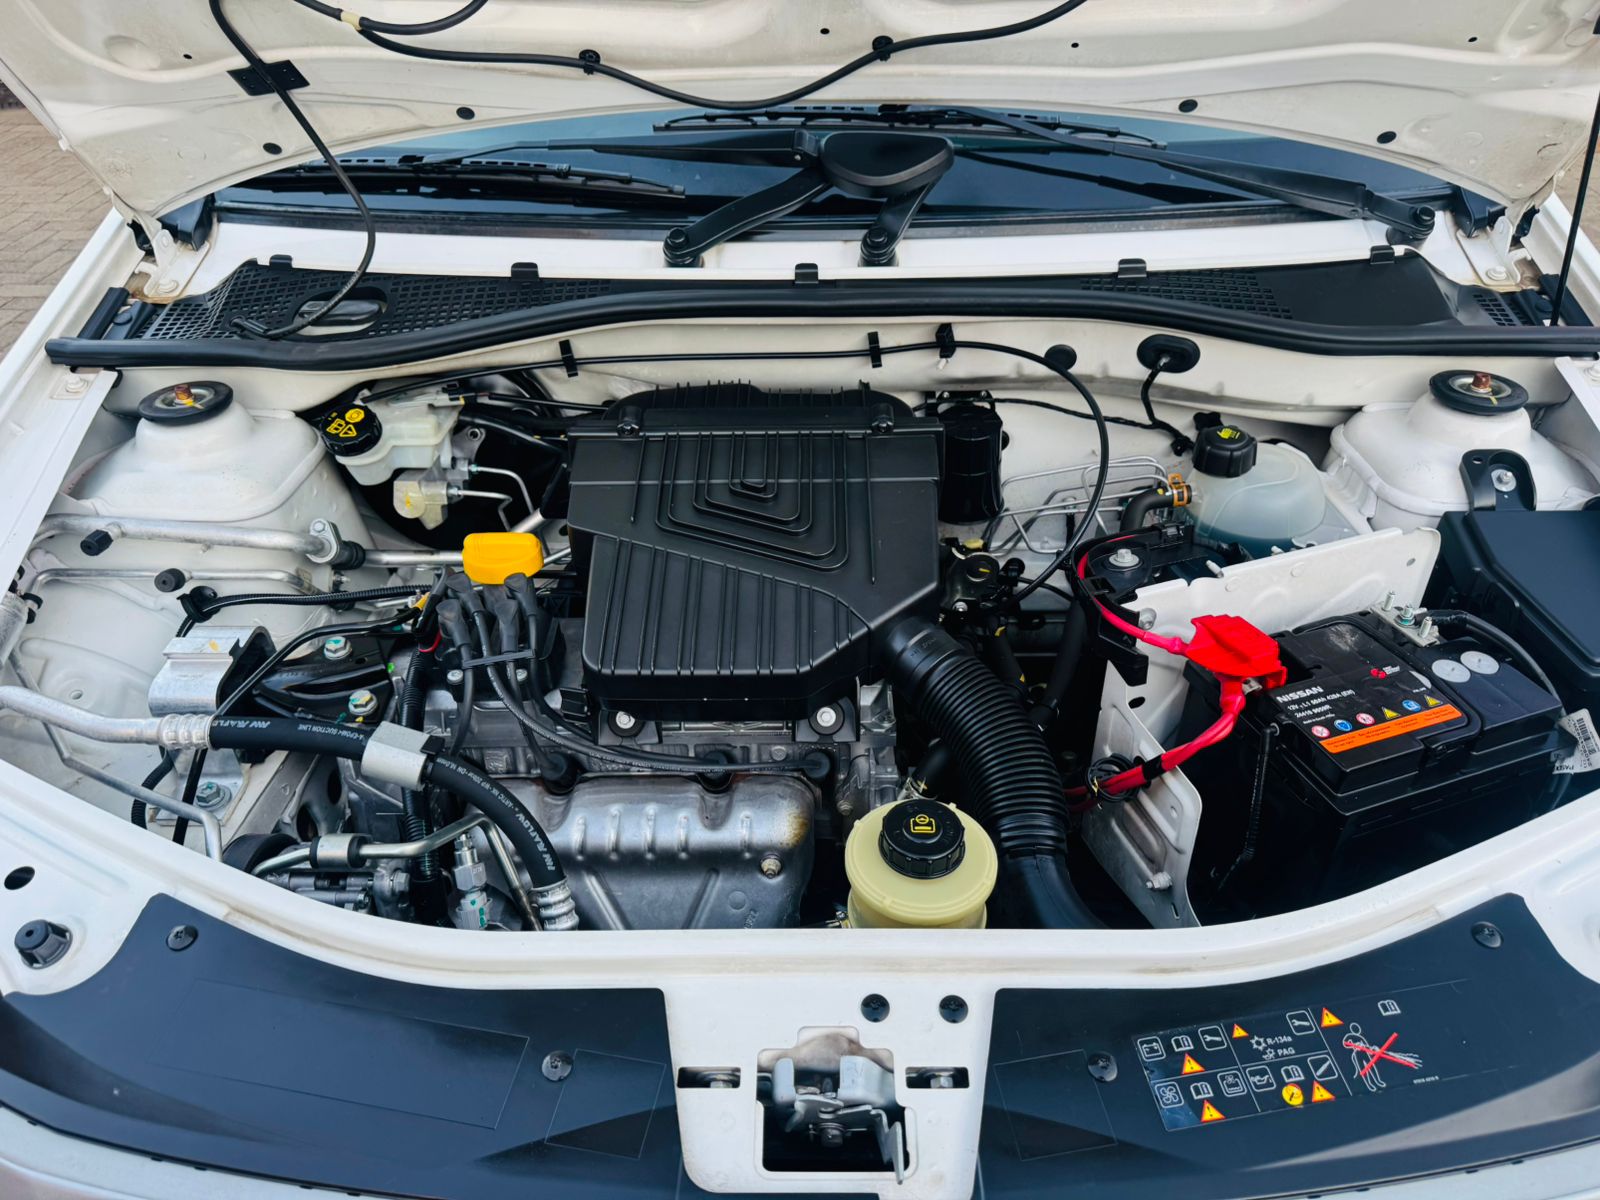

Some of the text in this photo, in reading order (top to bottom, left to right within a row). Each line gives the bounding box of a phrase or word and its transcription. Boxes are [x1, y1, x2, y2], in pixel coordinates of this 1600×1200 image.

[1276, 686, 1324, 703] NISSAN
[297, 723, 311, 732] LINE
[311, 725, 338, 735] SUCTION
[1266, 1035, 1292, 1045] R-134a
[1277, 1047, 1295, 1056] PAG
